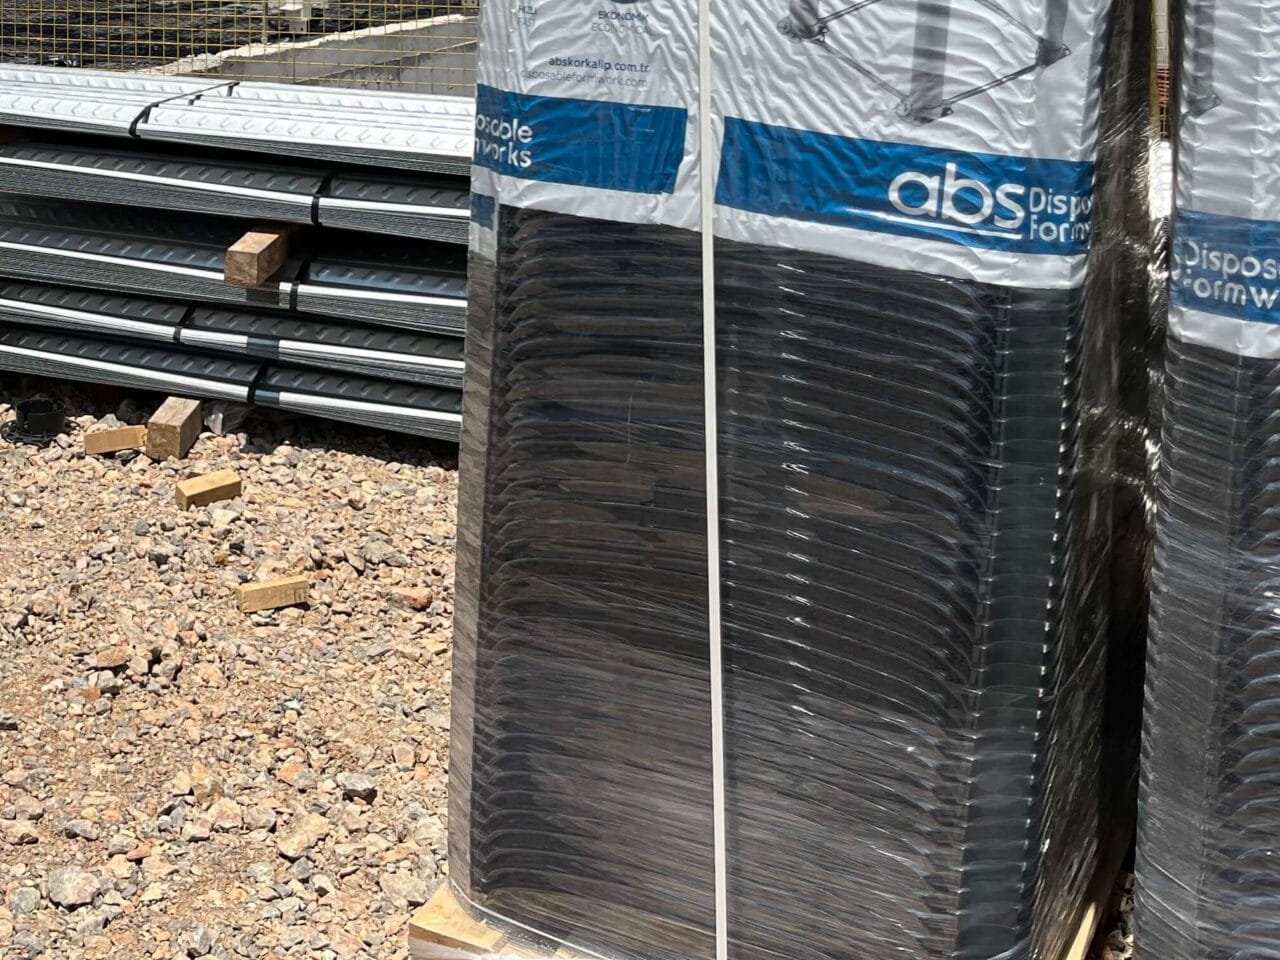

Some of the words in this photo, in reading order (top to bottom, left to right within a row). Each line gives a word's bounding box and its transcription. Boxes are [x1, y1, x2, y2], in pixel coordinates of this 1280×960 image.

[476, 114, 533, 144] osable
[888, 162, 1025, 229] abs
[1029, 186, 1094, 222] Dispo
[1185, 240, 1280, 280] Dispos
